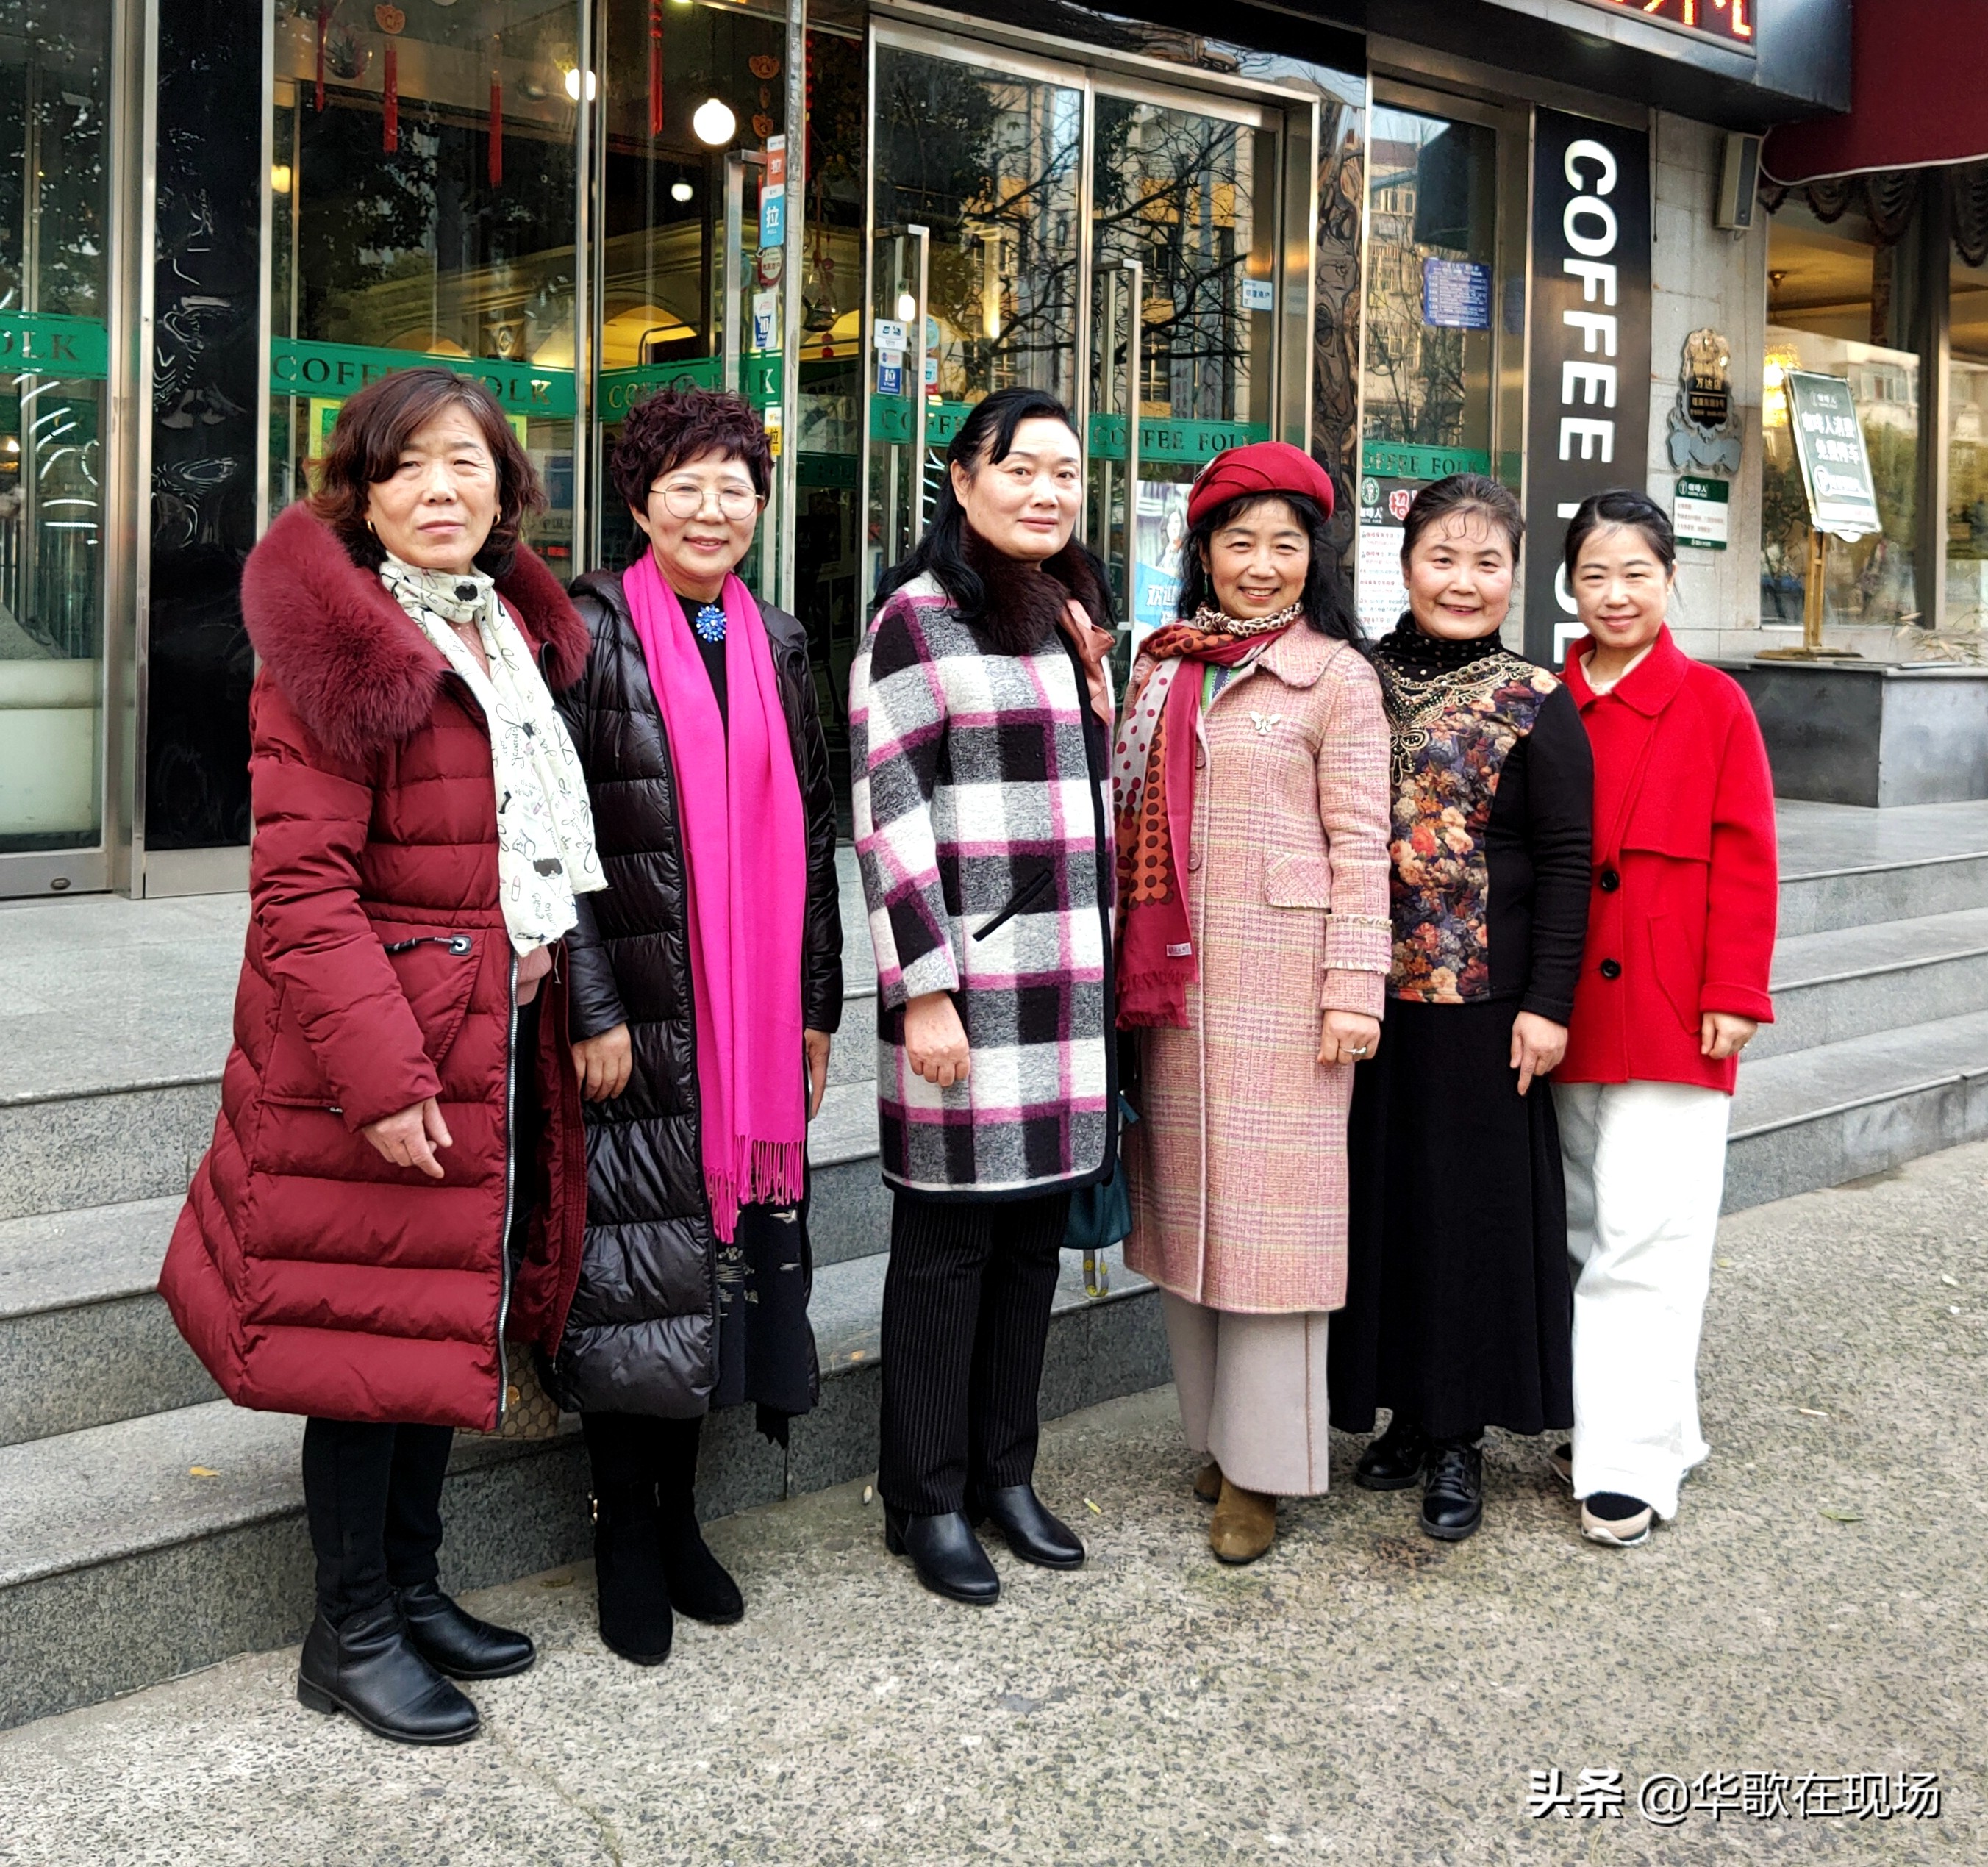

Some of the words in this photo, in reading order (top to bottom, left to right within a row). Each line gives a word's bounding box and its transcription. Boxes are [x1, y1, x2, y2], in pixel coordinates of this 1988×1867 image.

[766, 206, 779, 228] 拉
[1557, 139, 1618, 465] COFFEE
[456, 372, 551, 404] OLK
[1093, 426, 1184, 451] COFEE
[1815, 438, 1860, 465] 免费停车
